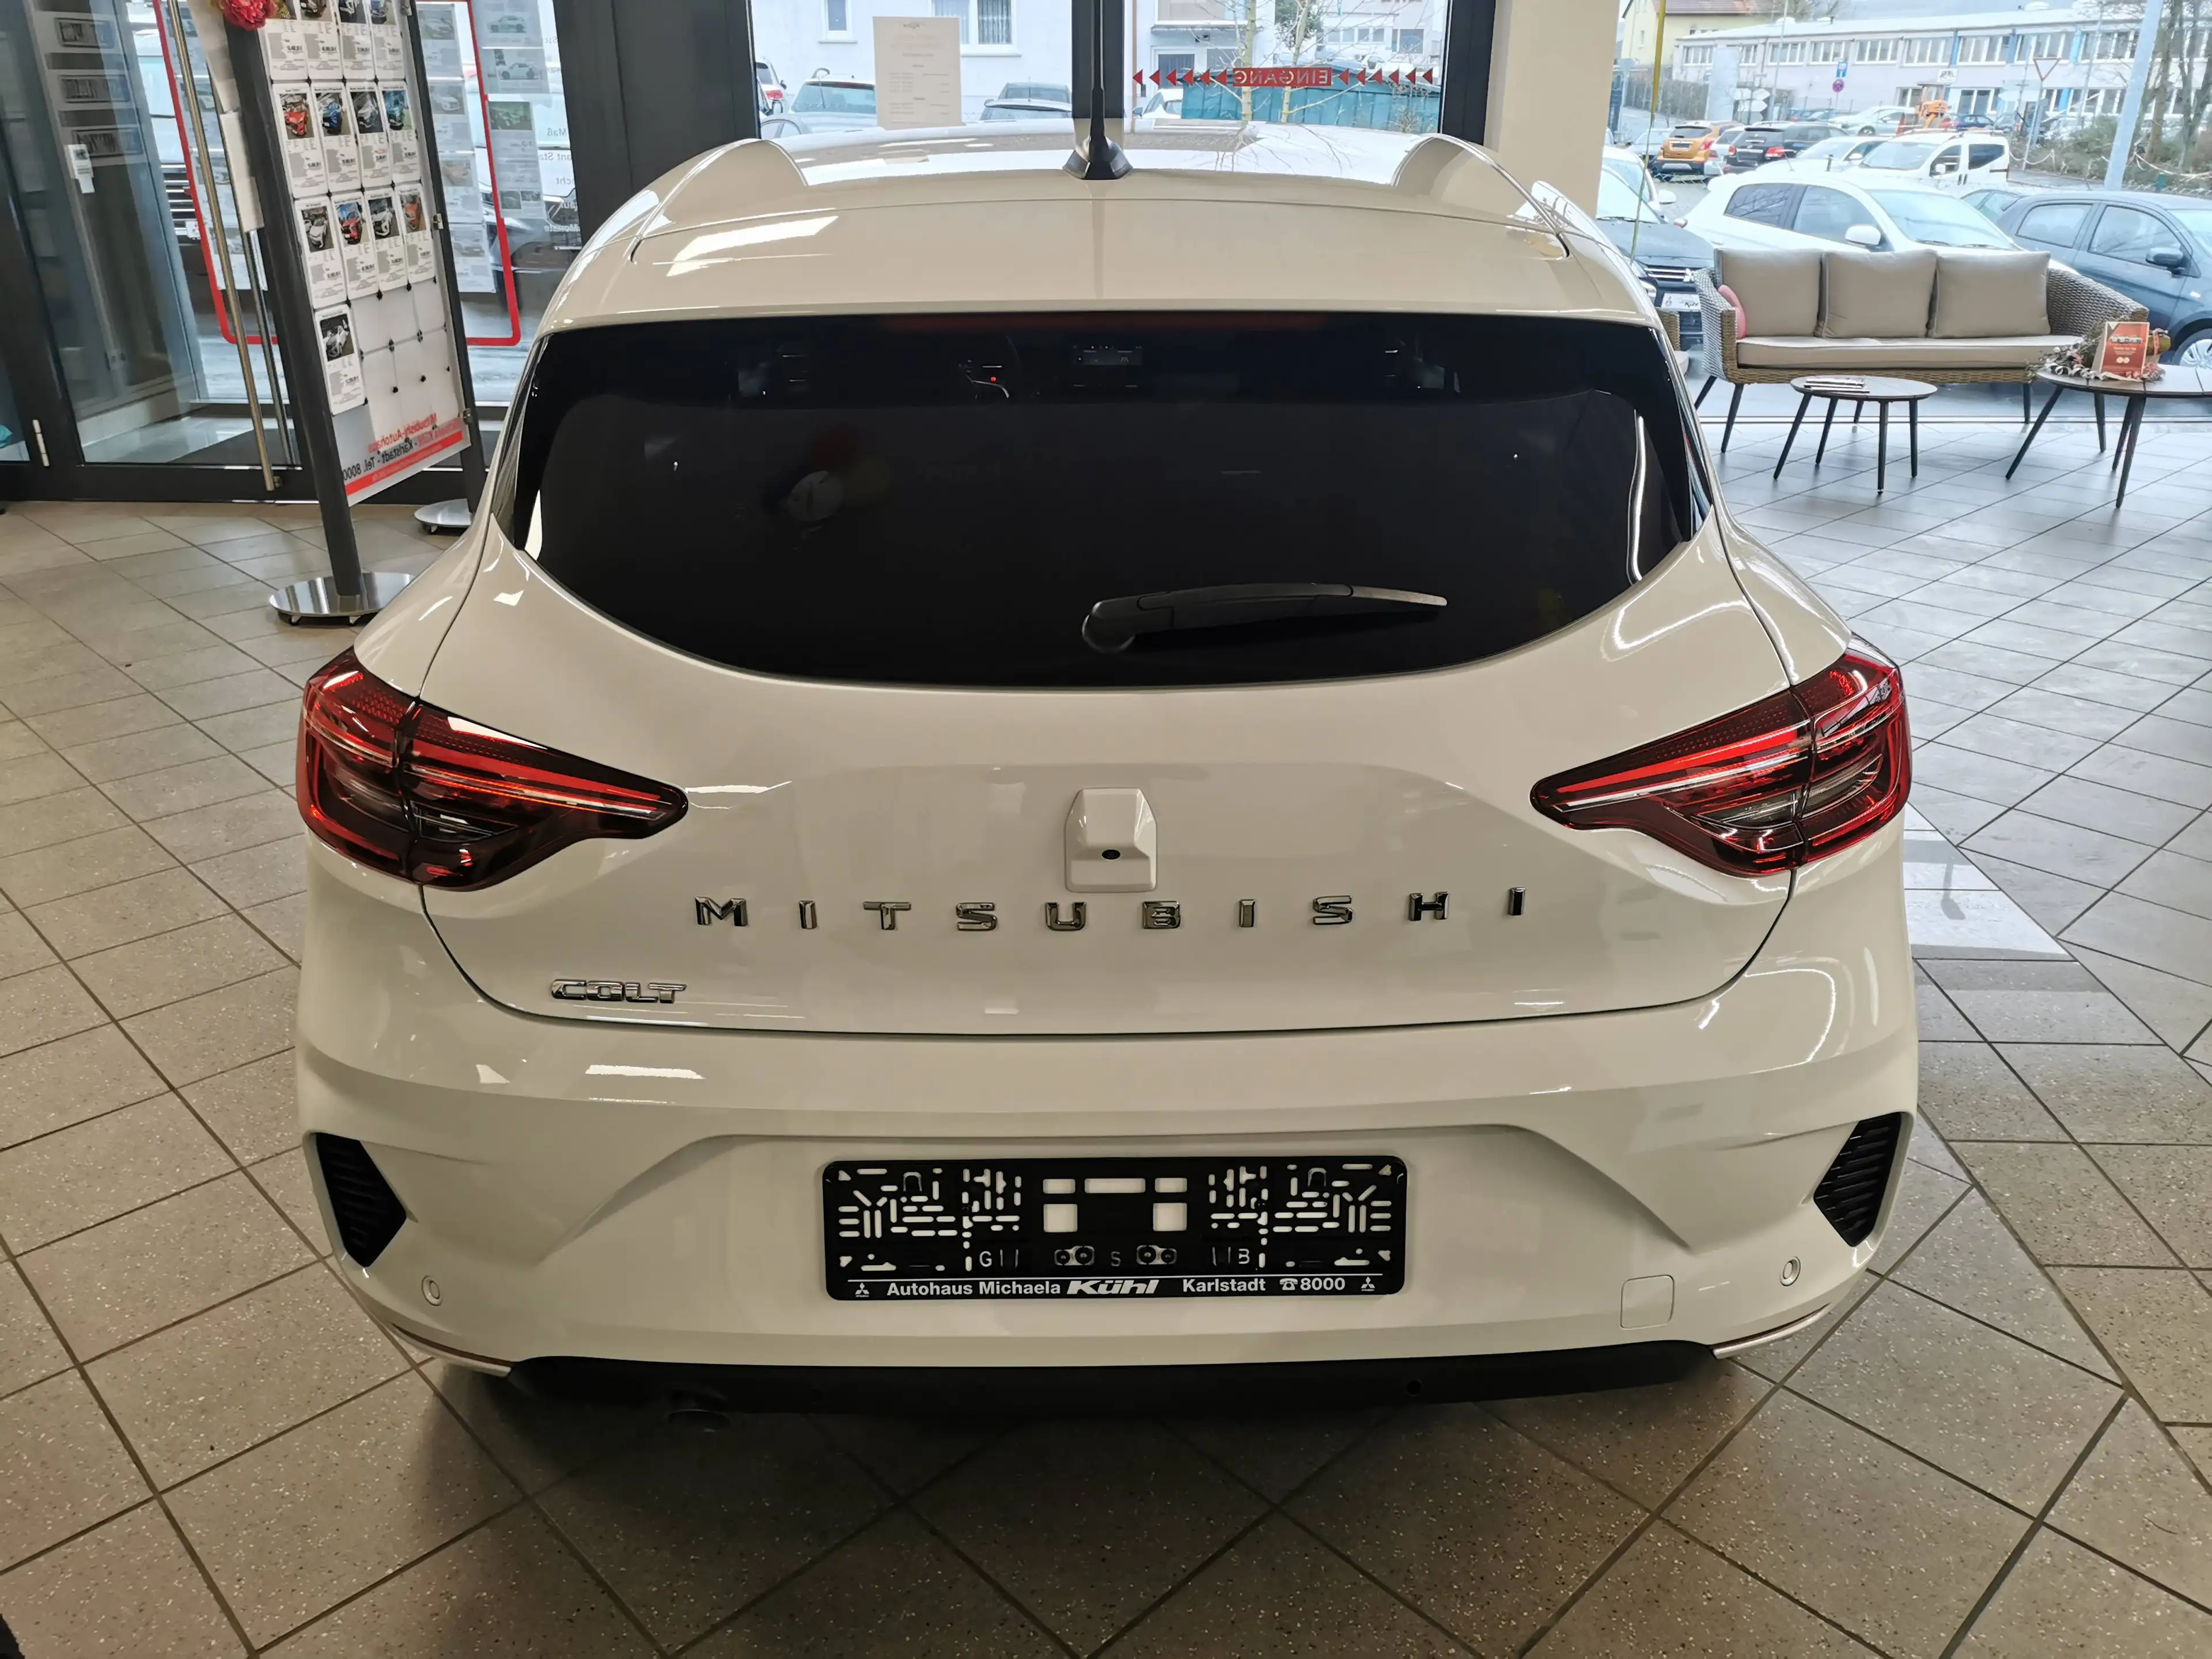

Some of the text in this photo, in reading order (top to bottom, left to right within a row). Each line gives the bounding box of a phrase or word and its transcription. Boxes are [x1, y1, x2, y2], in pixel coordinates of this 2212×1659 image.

[695, 887, 1528, 931] MITSUBISHI
[551, 979, 688, 1004] COLT
[887, 1277, 1346, 1296] Autohaus Michaela Kühl Karlstadt 8000
